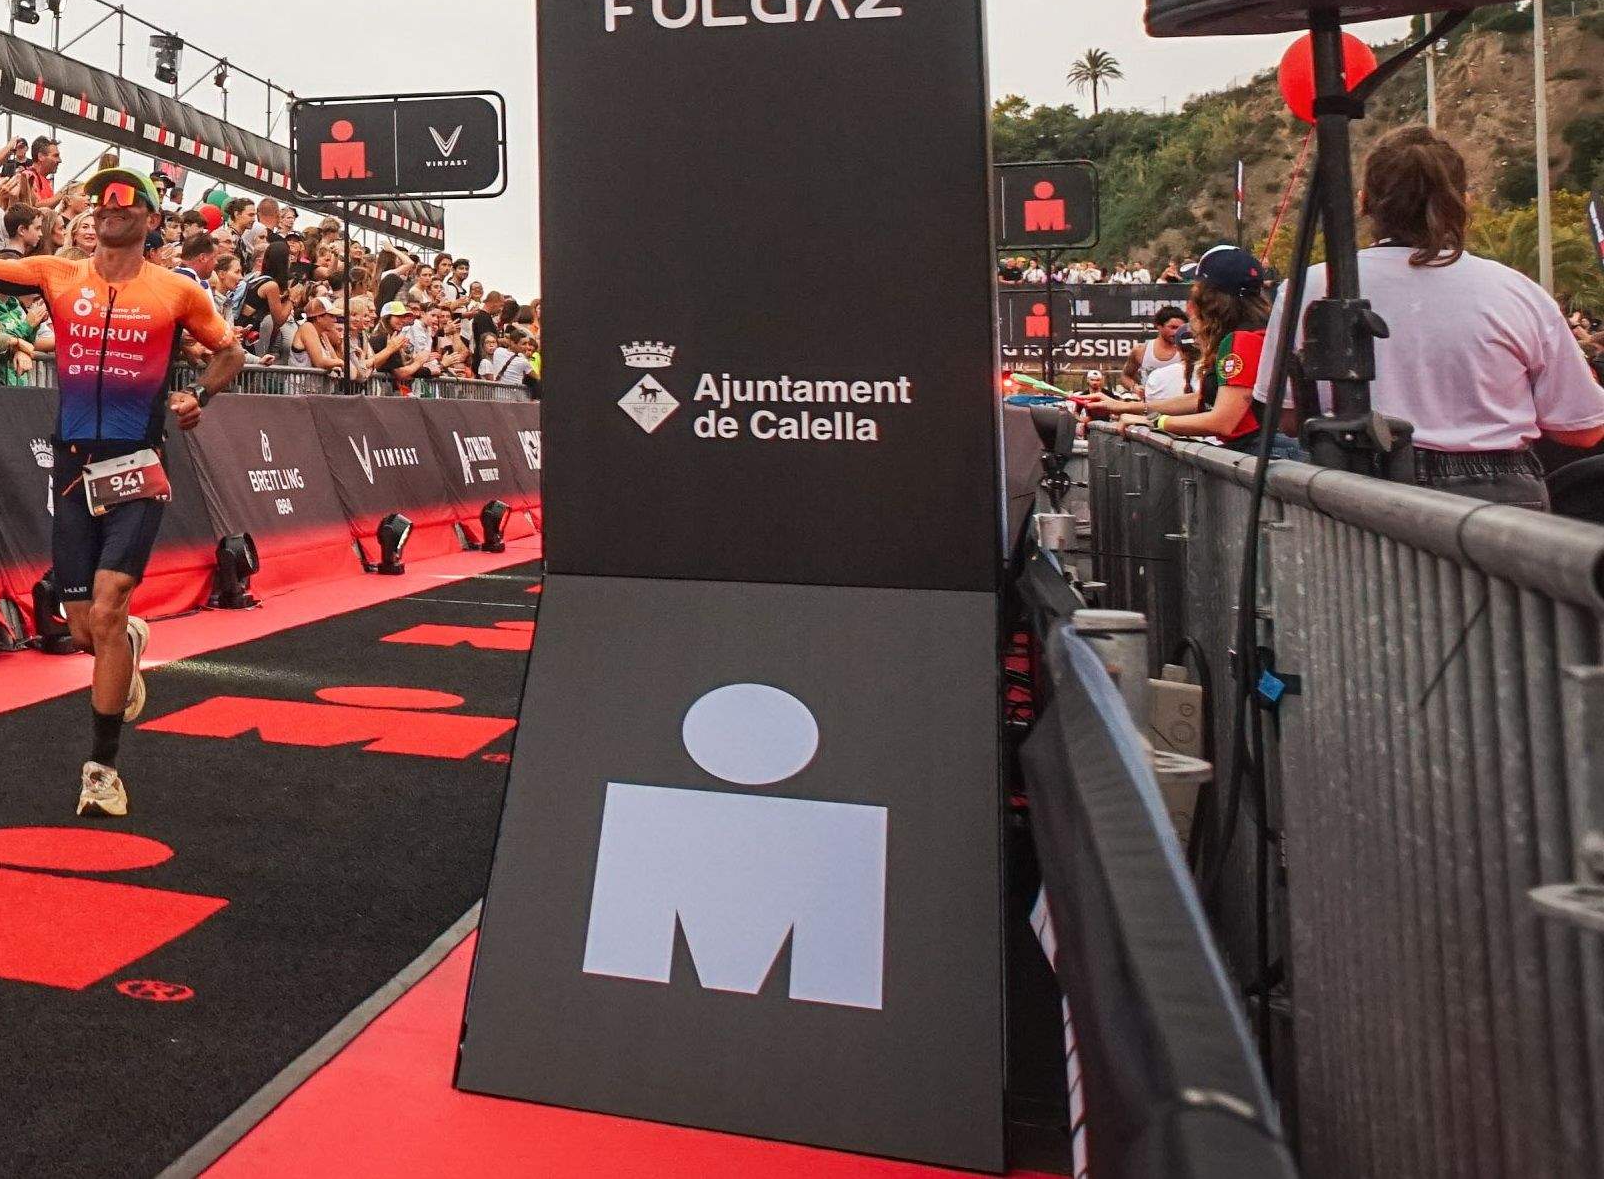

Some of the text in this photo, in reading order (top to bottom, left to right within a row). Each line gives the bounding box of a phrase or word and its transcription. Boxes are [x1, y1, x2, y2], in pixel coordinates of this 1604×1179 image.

[70, 322, 148, 343] KIPRUN
[1052, 339, 1137, 357] OSSIB
[694, 373, 912, 409] Ajuntament
[694, 410, 878, 441] de Calella
[373, 448, 419, 467] VINFAST
[110, 471, 145, 491] 941
[248, 468, 305, 492] BREITLING
